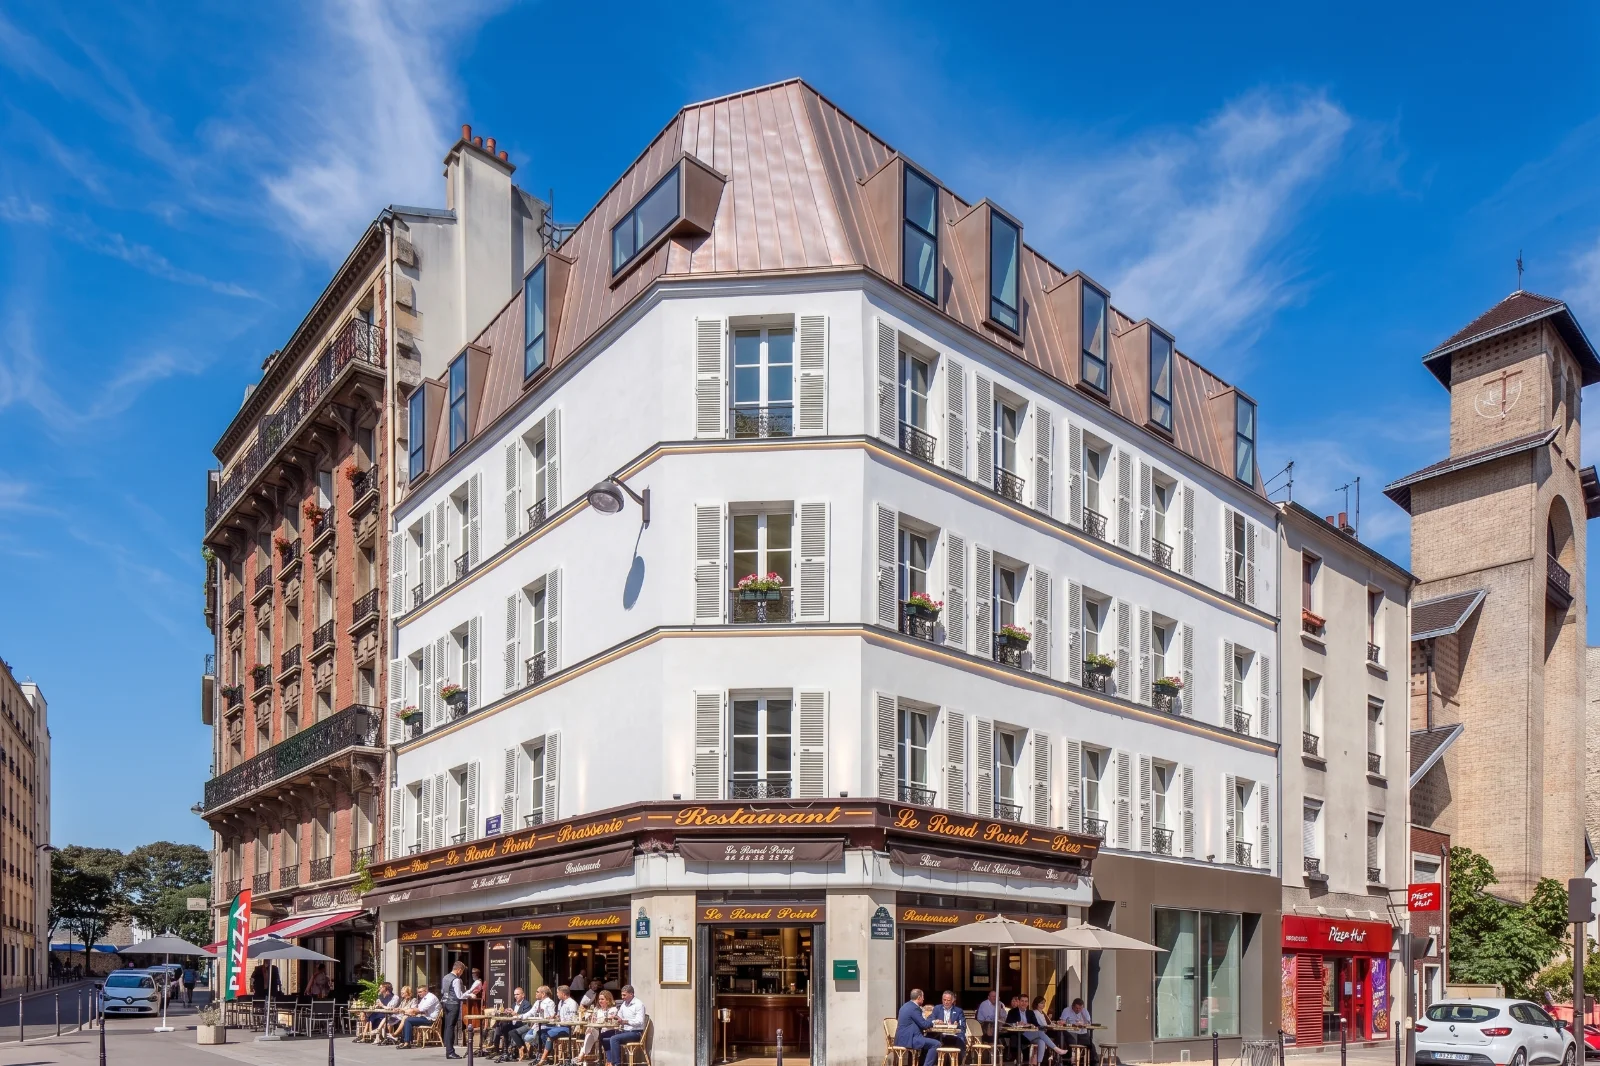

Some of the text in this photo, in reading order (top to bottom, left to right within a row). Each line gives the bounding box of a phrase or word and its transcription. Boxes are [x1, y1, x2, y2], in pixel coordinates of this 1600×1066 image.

[675, 806, 842, 826] Restaurant
[894, 808, 920, 829] Le
[927, 814, 979, 838] Rond
[983, 823, 1029, 846] Point
[446, 850, 460, 866] Le
[464, 842, 496, 863] Rond
[501, 833, 536, 855] Point
[557, 817, 625, 843] Brasserie
[703, 907, 818, 920] Le Rond Point
[229, 902, 247, 990] PIZZA
[1328, 926, 1367, 943] Pizza Hut
